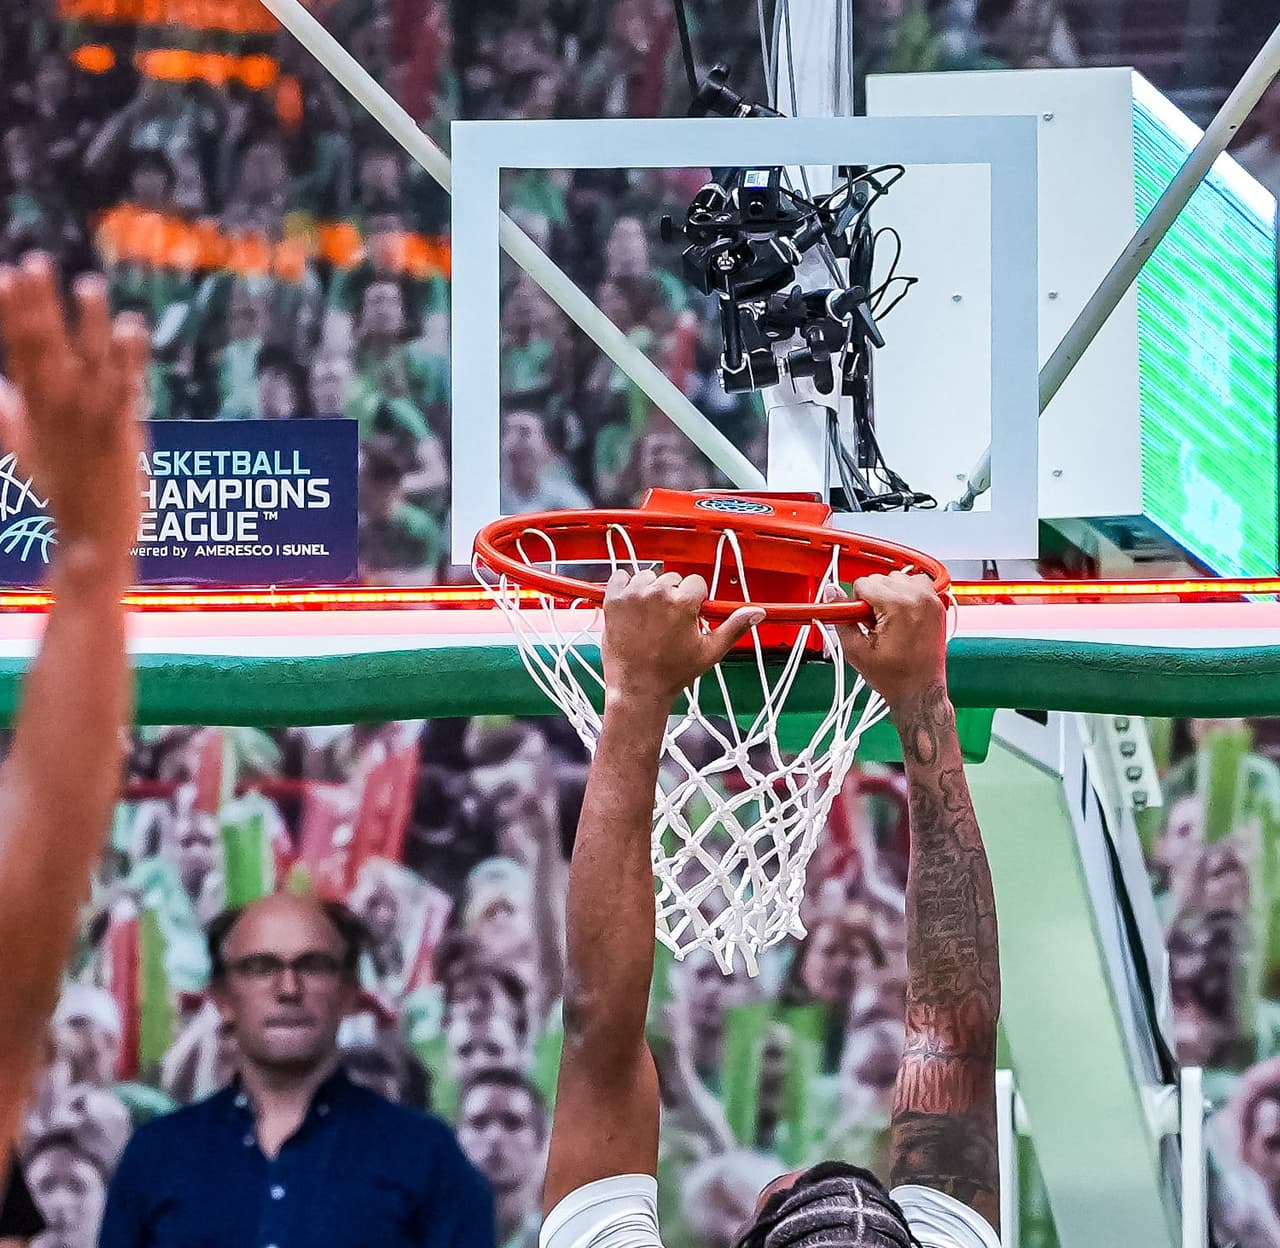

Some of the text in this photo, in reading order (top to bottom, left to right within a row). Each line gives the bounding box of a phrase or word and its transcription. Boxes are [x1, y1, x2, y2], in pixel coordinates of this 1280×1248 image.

[137, 450, 311, 476] ASKETBALL
[141, 478, 331, 509] HAMPIONS
[137, 511, 259, 542] EAGUE
[130, 544, 329, 559] wered by AMERESCO SUNEL
